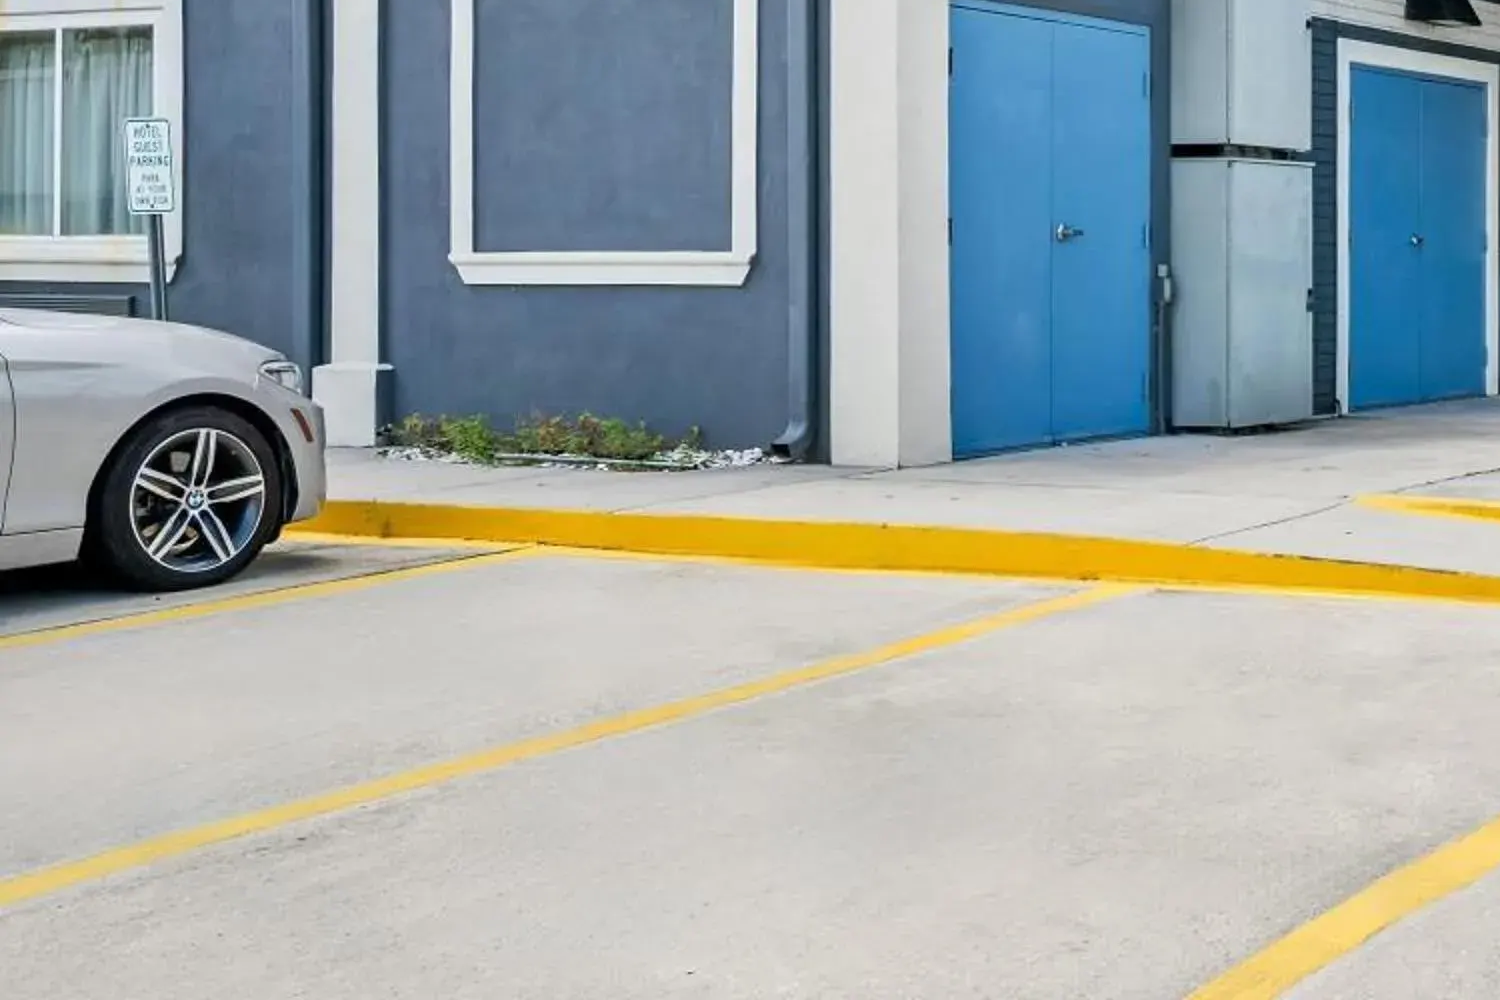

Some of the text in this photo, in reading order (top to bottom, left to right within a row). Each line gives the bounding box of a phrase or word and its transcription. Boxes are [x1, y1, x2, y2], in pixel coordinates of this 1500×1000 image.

[133, 128, 162, 139] HOTEL
[133, 141, 163, 153] GUEST
[130, 156, 170, 167] PARKING
